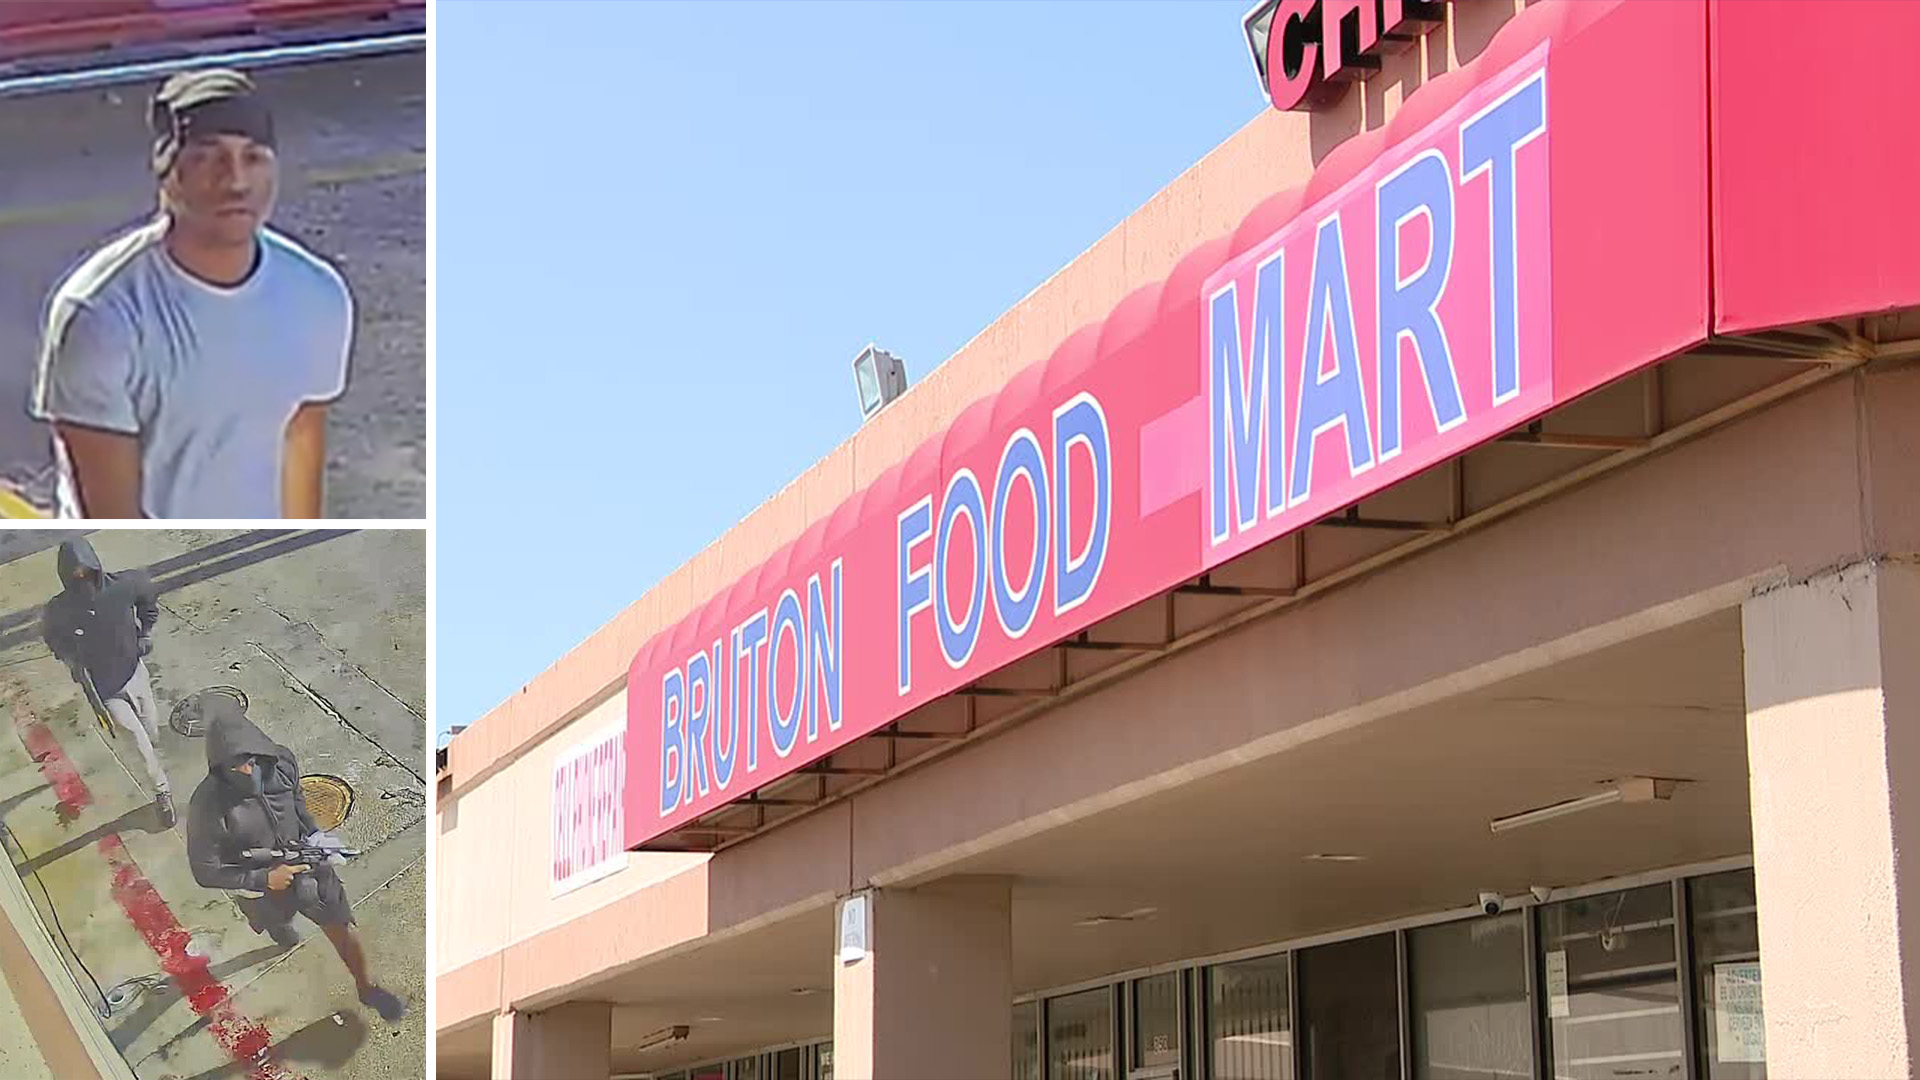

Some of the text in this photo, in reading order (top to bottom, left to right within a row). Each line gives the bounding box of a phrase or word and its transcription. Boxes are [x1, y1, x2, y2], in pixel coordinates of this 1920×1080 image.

[660, 66, 1546, 817] BRUTON FOOD MART
